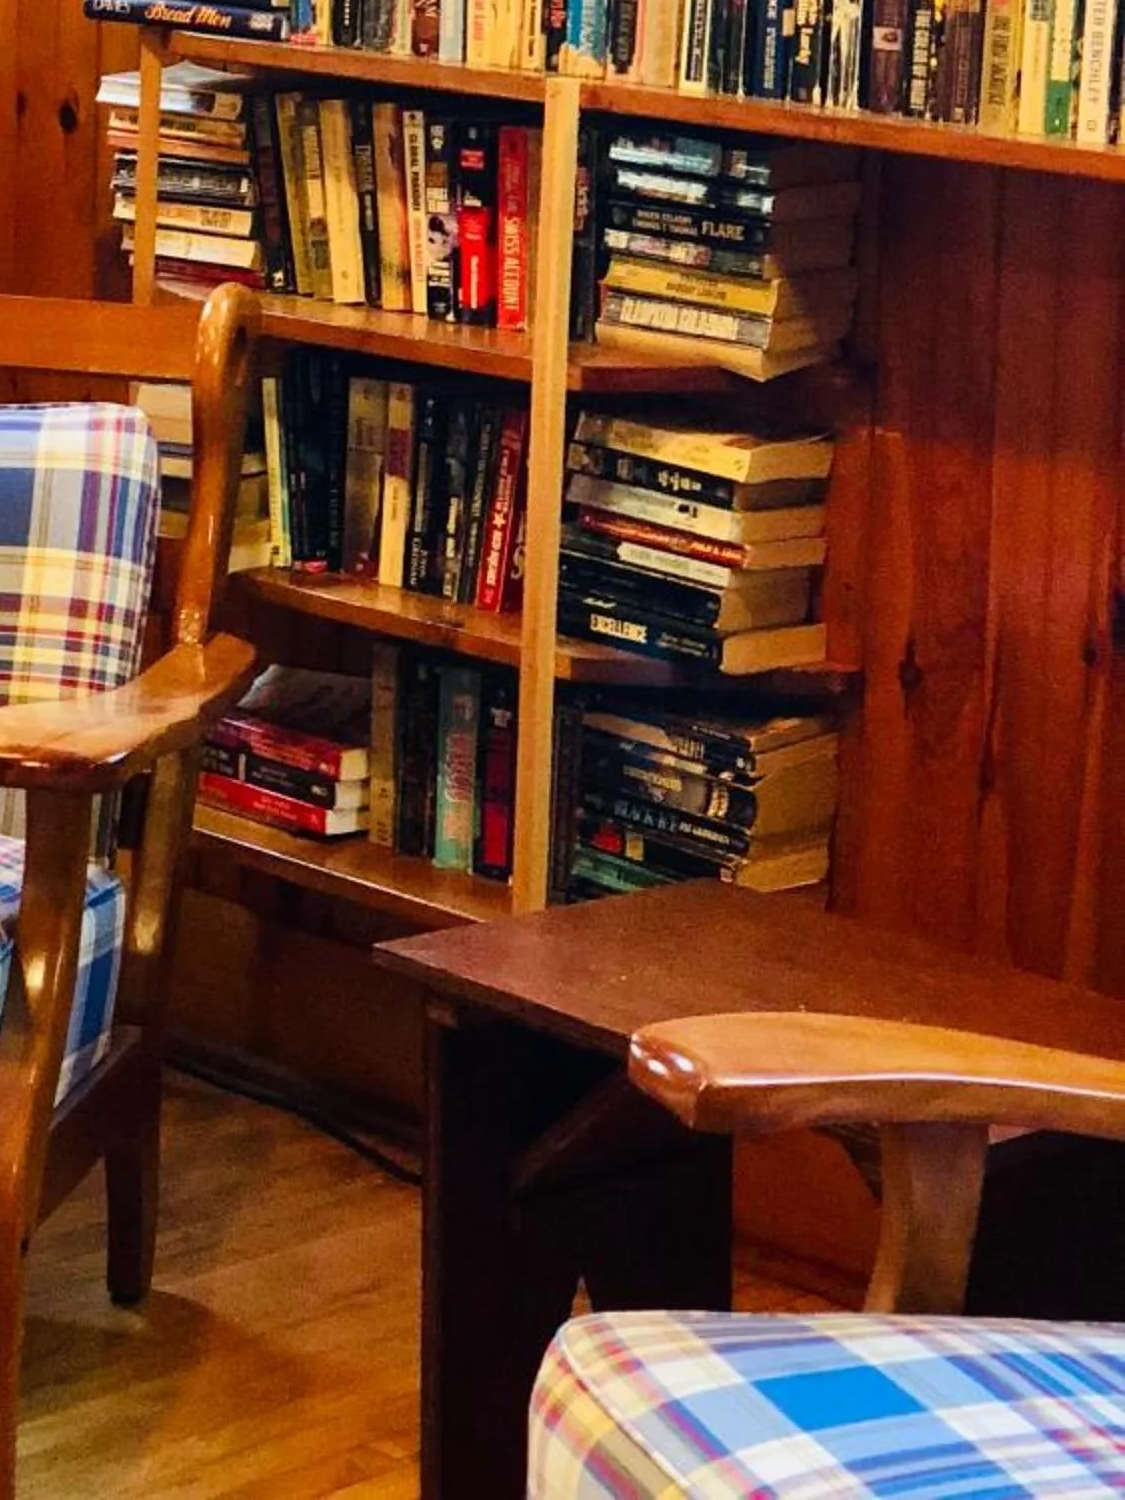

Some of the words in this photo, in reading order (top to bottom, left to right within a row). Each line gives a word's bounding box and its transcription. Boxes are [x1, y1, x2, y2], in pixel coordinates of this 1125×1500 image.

[1088, 31, 1107, 106] BENCHLEY
[503, 216, 522, 255] SWISS
[701, 219, 746, 242] FLARE
[504, 256, 523, 312] ACCOUNT
